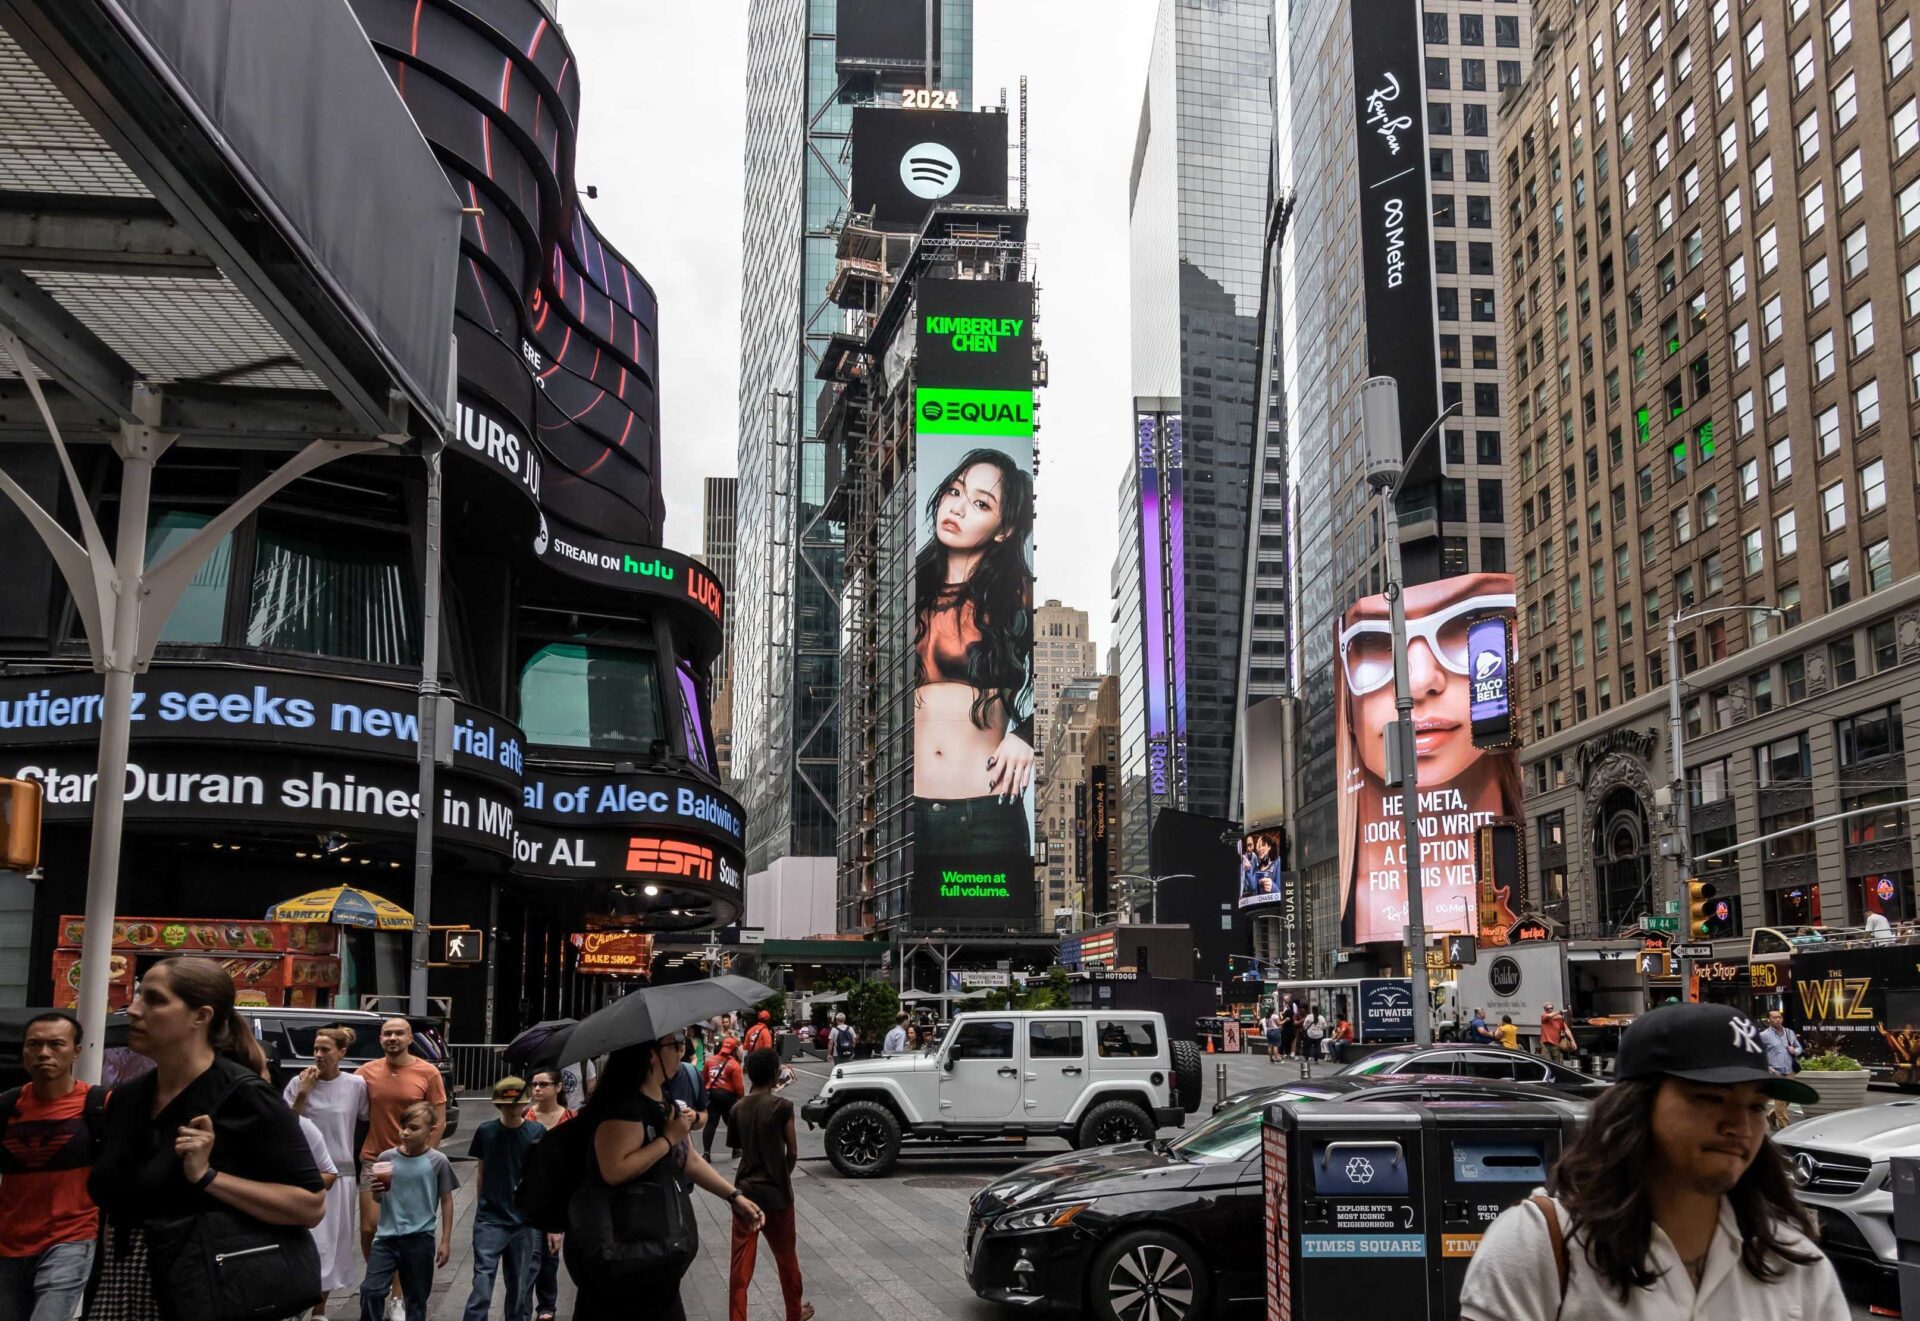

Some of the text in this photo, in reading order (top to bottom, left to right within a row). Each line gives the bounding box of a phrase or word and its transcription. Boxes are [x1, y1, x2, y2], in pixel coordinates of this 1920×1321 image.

[902, 89, 959, 110] 2024
[1386, 227, 1405, 288] Meta
[926, 316, 1023, 336] KIMBERLEY
[952, 334, 997, 352] CHEN
[522, 337, 541, 370] ERE
[947, 402, 1028, 422] EQUAL
[554, 538, 598, 566] STREAM
[601, 556, 621, 571] ON
[624, 555, 674, 580] hulu
[1474, 679, 1503, 693] TACO
[1477, 689, 1504, 702] BELL
[0, 689, 146, 728] utierrz
[159, 686, 315, 728] seeks
[331, 703, 419, 742] new
[453, 719, 495, 760] rial
[123, 763, 263, 805] Duran
[443, 789, 469, 827] in
[478, 797, 514, 840] MVP
[553, 786, 590, 813] of
[596, 784, 669, 813] Alec
[677, 787, 732, 833] Baldwin
[1382, 789, 1467, 816] HE META,
[1364, 821, 1400, 843] LOOK
[1404, 817, 1437, 840] ND
[513, 831, 543, 863] for
[549, 839, 596, 867] AL
[626, 837, 713, 881] ESPN
[1384, 839, 1469, 867] A CPTION
[942, 871, 1006, 883] Women at
[1370, 870, 1400, 891] FOR
[940, 885, 1010, 897] full volume.
[1258, 894, 1274, 902] CHASE
[278, 910, 327, 919] SABRETT
[1286, 881, 1295, 929] SQUARE
[1649, 919, 1656, 927] W
[1660, 919, 1670, 927] 44
[584, 954, 636, 964] BAKE SHOP
[1676, 947, 1689, 955] ONE
[1105, 972, 1137, 980] HOTDOGS
[1493, 966, 1519, 985] Baldor
[1712, 962, 1736, 981] Shop
[1751, 964, 1765, 977] BIG
[1828, 969, 1842, 978] THE
[1752, 976, 1766, 987] BUS
[1796, 977, 1873, 1020] WIZ
[1368, 1008, 1413, 1018] CUTWATER
[1304, 1240, 1421, 1253] TIMES SQUARE
